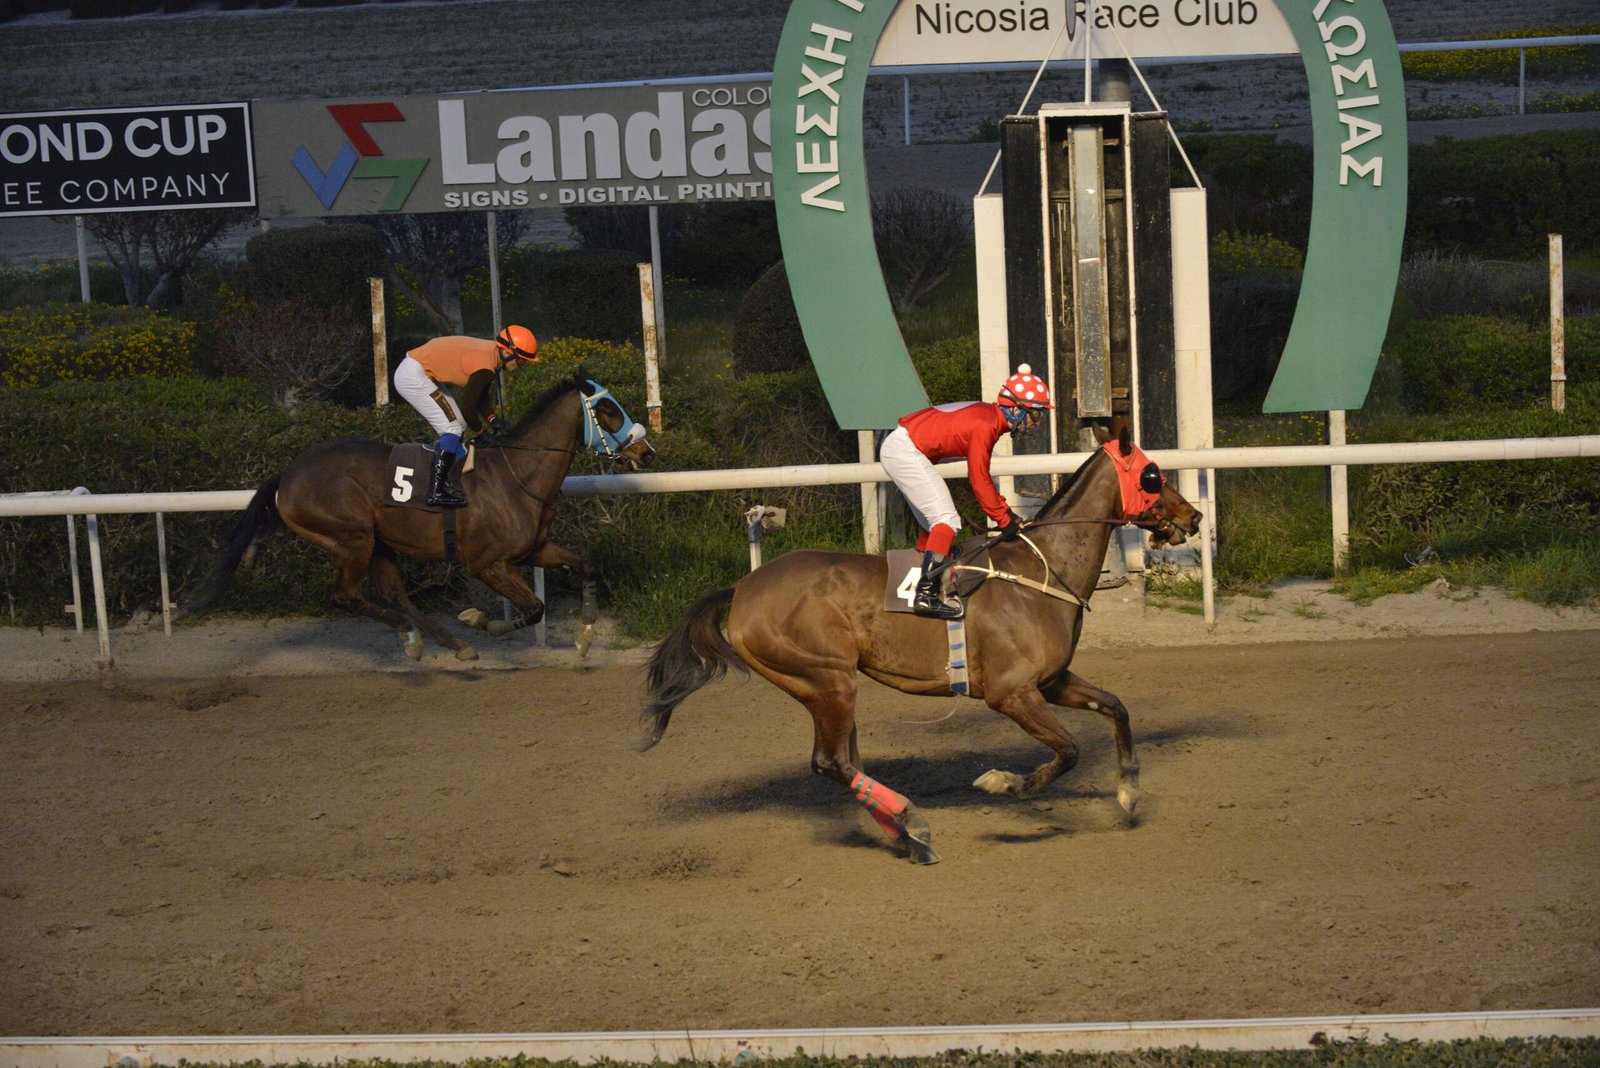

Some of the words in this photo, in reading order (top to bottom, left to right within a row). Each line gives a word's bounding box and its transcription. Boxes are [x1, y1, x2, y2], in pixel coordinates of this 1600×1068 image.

[916, 1, 1050, 35] Nicosia
[1174, 0, 1258, 27] Club
[692, 86, 772, 107] COLO
[795, 22, 853, 212] ΛΕΣΧΗ
[0, 122, 113, 164] OND
[124, 114, 227, 158] CUP
[4, 182, 43, 205] EE
[60, 172, 230, 203] COMPANY
[444, 189, 529, 208] SIGNS
[559, 185, 669, 204] DIGITAL
[678, 181, 772, 199] PRINTI
[391, 466, 414, 503] 5
[897, 567, 922, 607] 4
